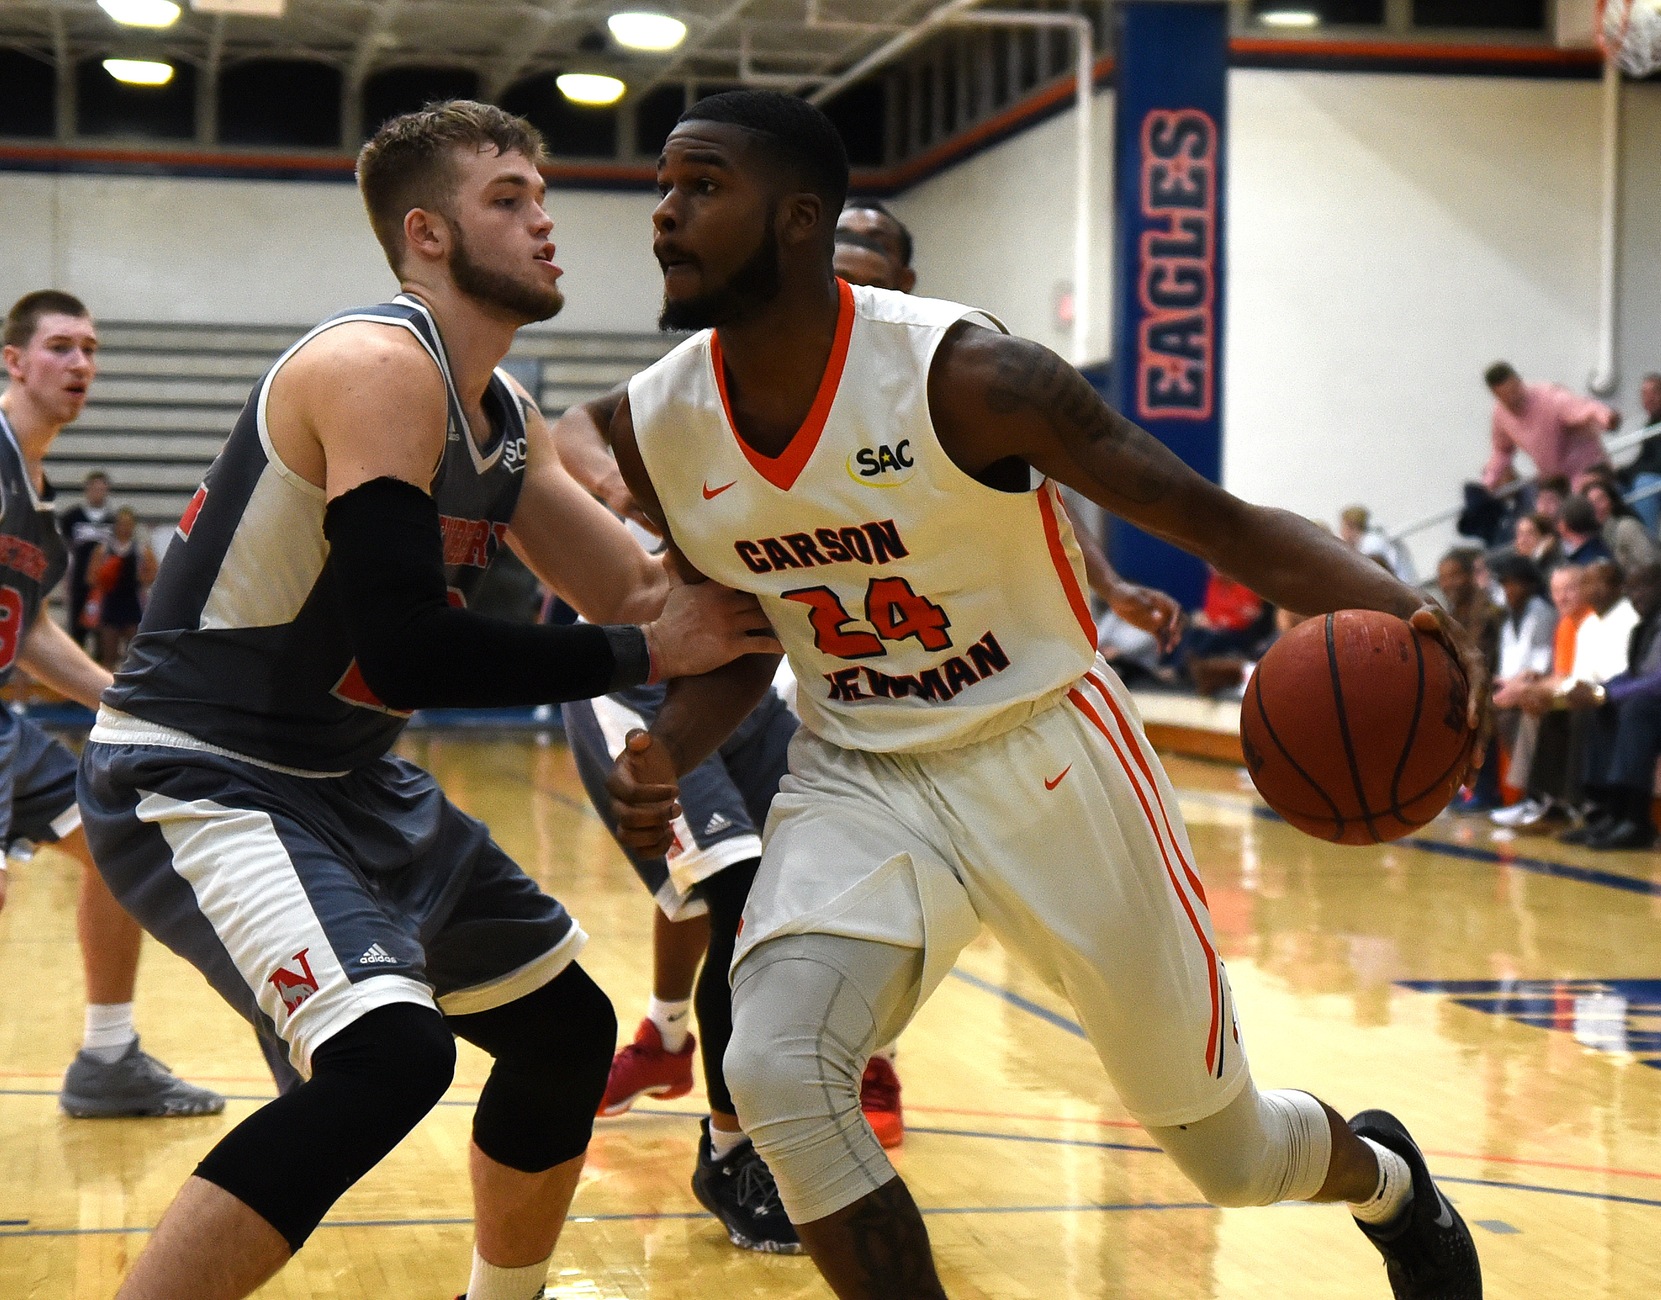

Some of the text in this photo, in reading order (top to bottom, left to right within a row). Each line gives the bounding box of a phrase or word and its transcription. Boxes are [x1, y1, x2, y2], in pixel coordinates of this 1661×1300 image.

[1140, 109, 1214, 416] EAGLES
[856, 439, 914, 476] SAC
[734, 519, 909, 574] CARSON
[780, 577, 952, 660] 24
[359, 955, 398, 965] adidas
